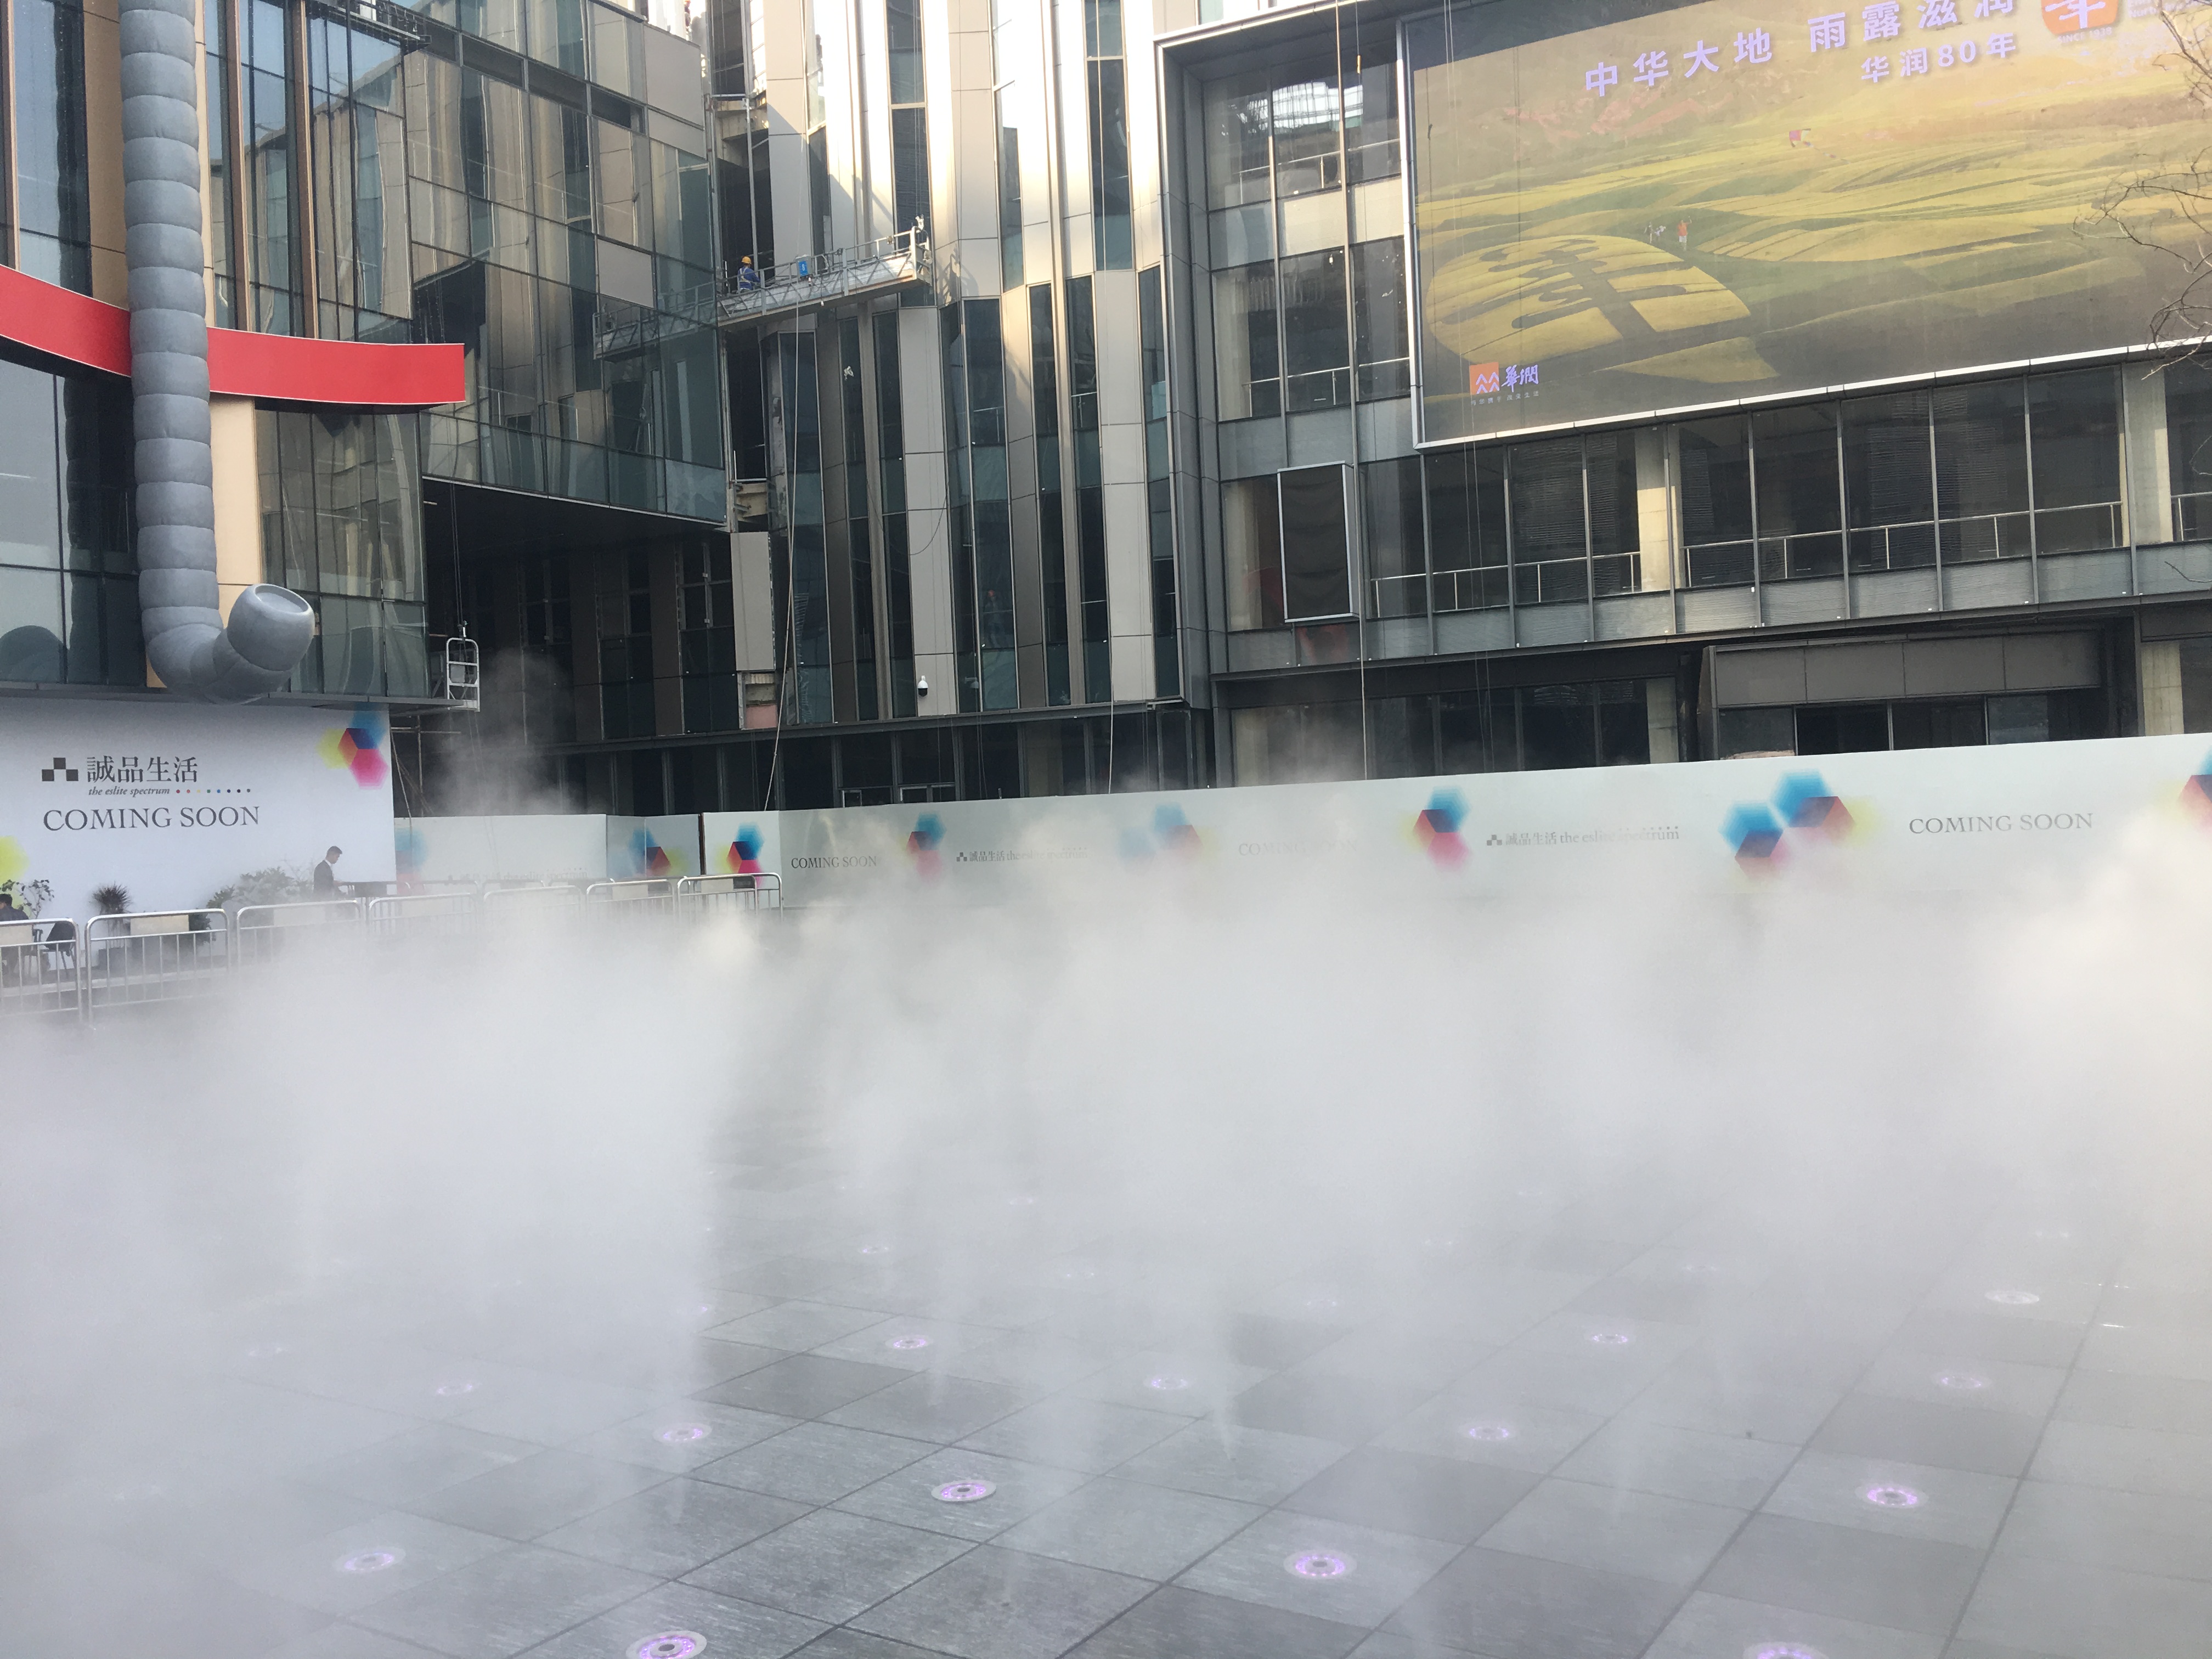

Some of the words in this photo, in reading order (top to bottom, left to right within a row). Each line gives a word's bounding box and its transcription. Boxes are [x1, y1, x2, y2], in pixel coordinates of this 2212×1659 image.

[1585, 27, 1773, 97] 中华大地
[86, 755, 199, 783] 誠品生活
[88, 786, 103, 795] the
[105, 785, 128, 795] eslite
[129, 786, 170, 798] spectrum
[43, 806, 172, 832] COMING
[180, 805, 259, 828] SOON
[1909, 815, 2012, 834] COMING
[2020, 812, 2094, 831] SOON
[1560, 831, 1579, 843] the
[791, 856, 840, 869] COMING
[842, 855, 877, 868] SOON
[969, 850, 1005, 862] 誠品生活
[1007, 850, 1020, 861] the
